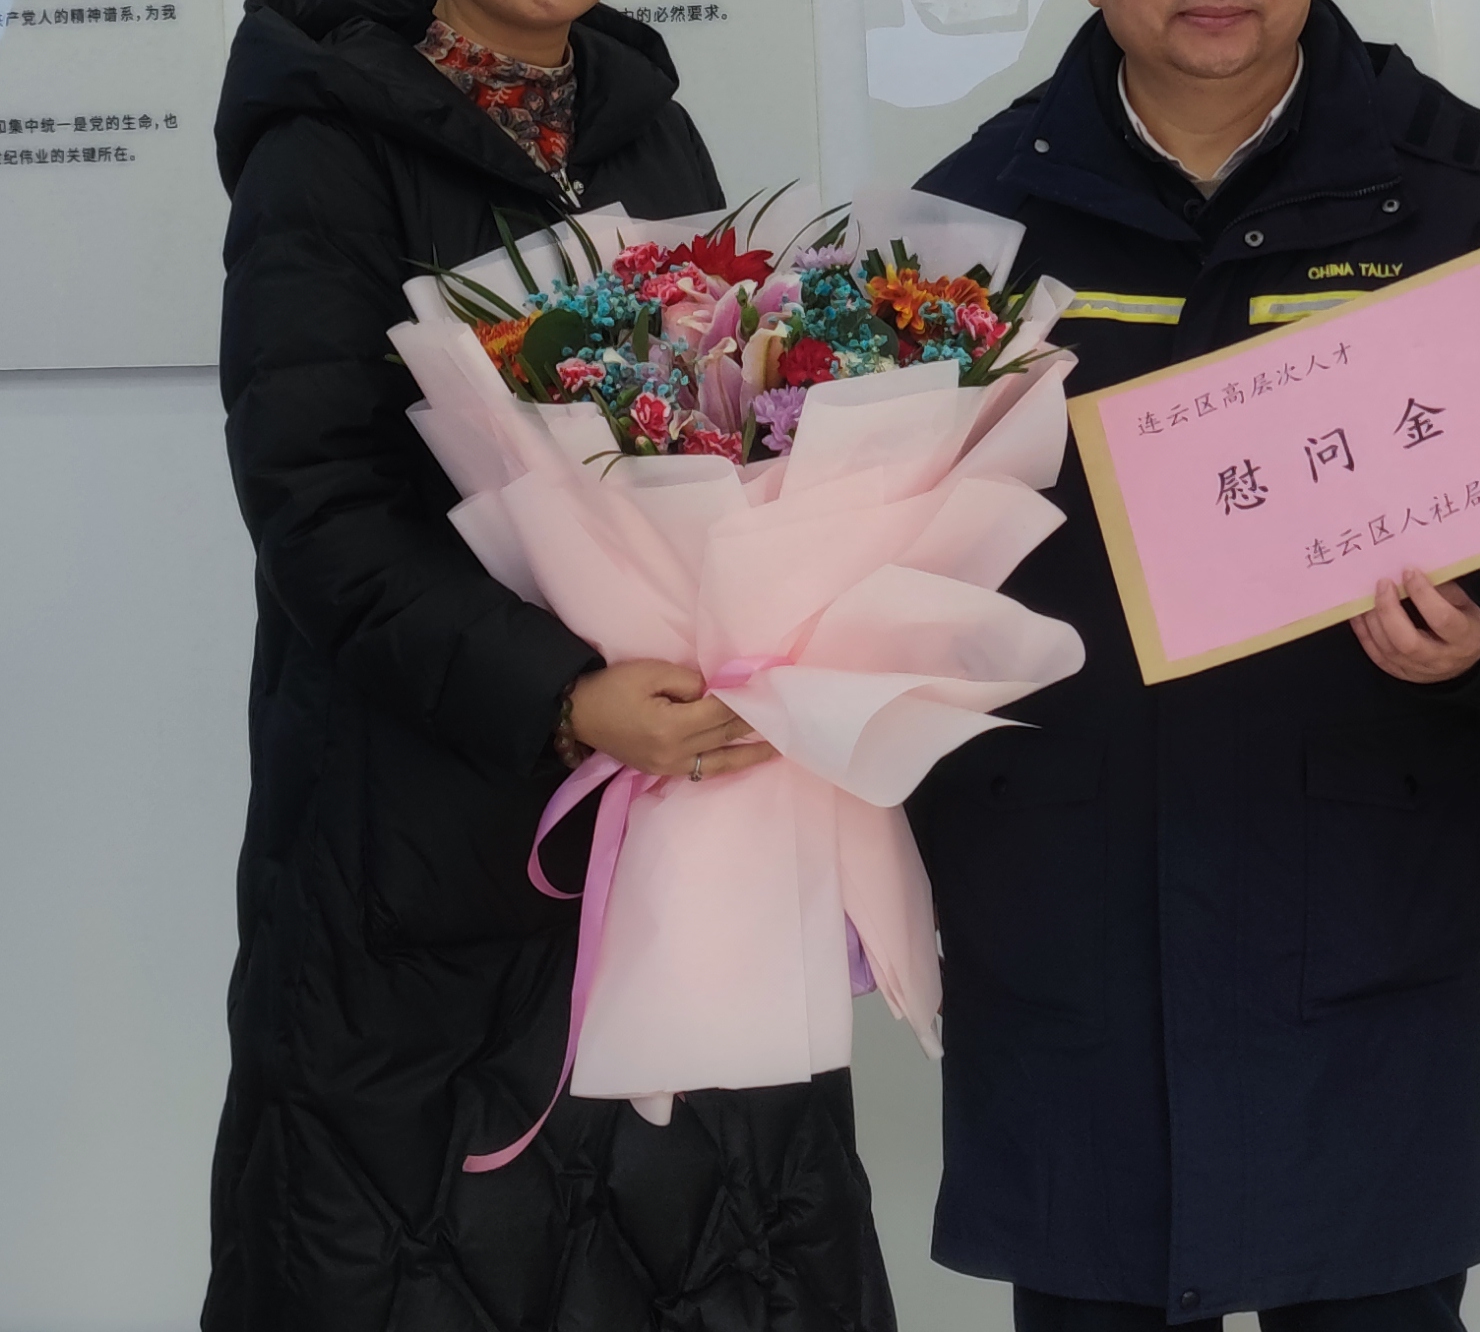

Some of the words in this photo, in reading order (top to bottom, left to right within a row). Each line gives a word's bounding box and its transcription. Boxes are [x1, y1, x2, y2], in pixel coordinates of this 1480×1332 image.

[1358, 262, 1404, 278] TALLY
[1138, 343, 1352, 436] 连云区高层次人才
[1216, 397, 1446, 515] 慰问金
